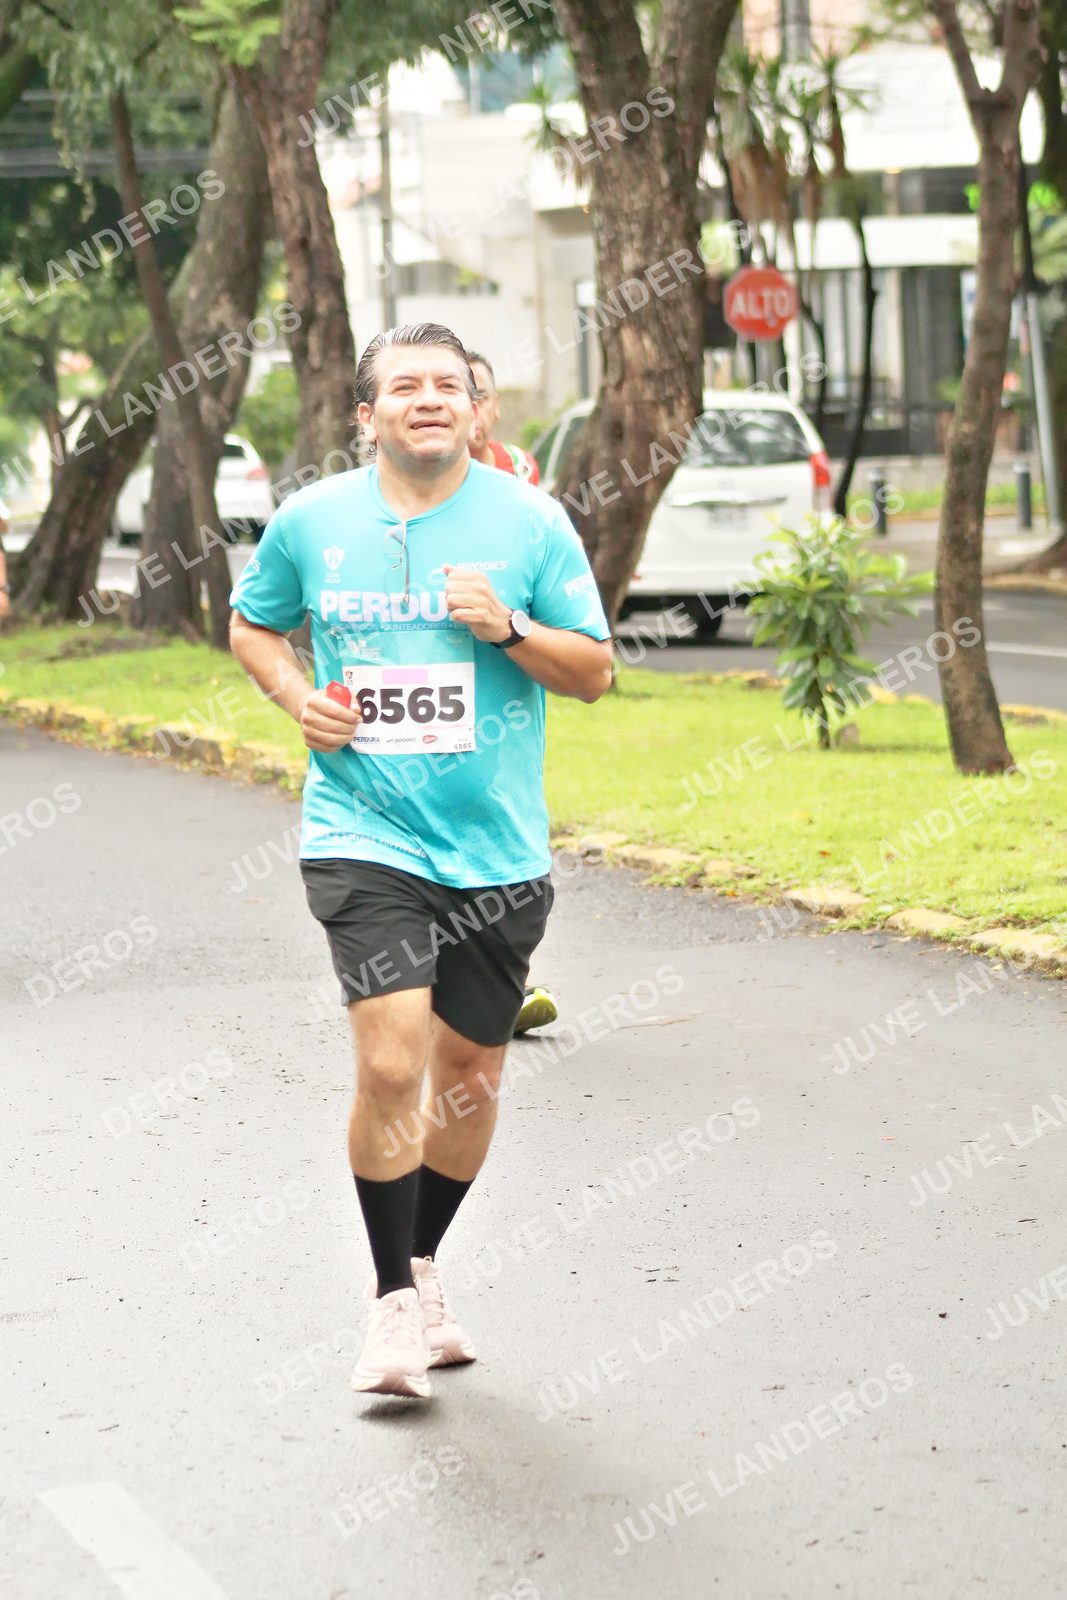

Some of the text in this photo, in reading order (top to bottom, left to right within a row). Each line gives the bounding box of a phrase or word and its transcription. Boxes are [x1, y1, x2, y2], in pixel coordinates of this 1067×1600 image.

[731, 288, 791, 319] ALTO
[320, 590, 452, 622] PERDU
[356, 686, 465, 724] 6565
